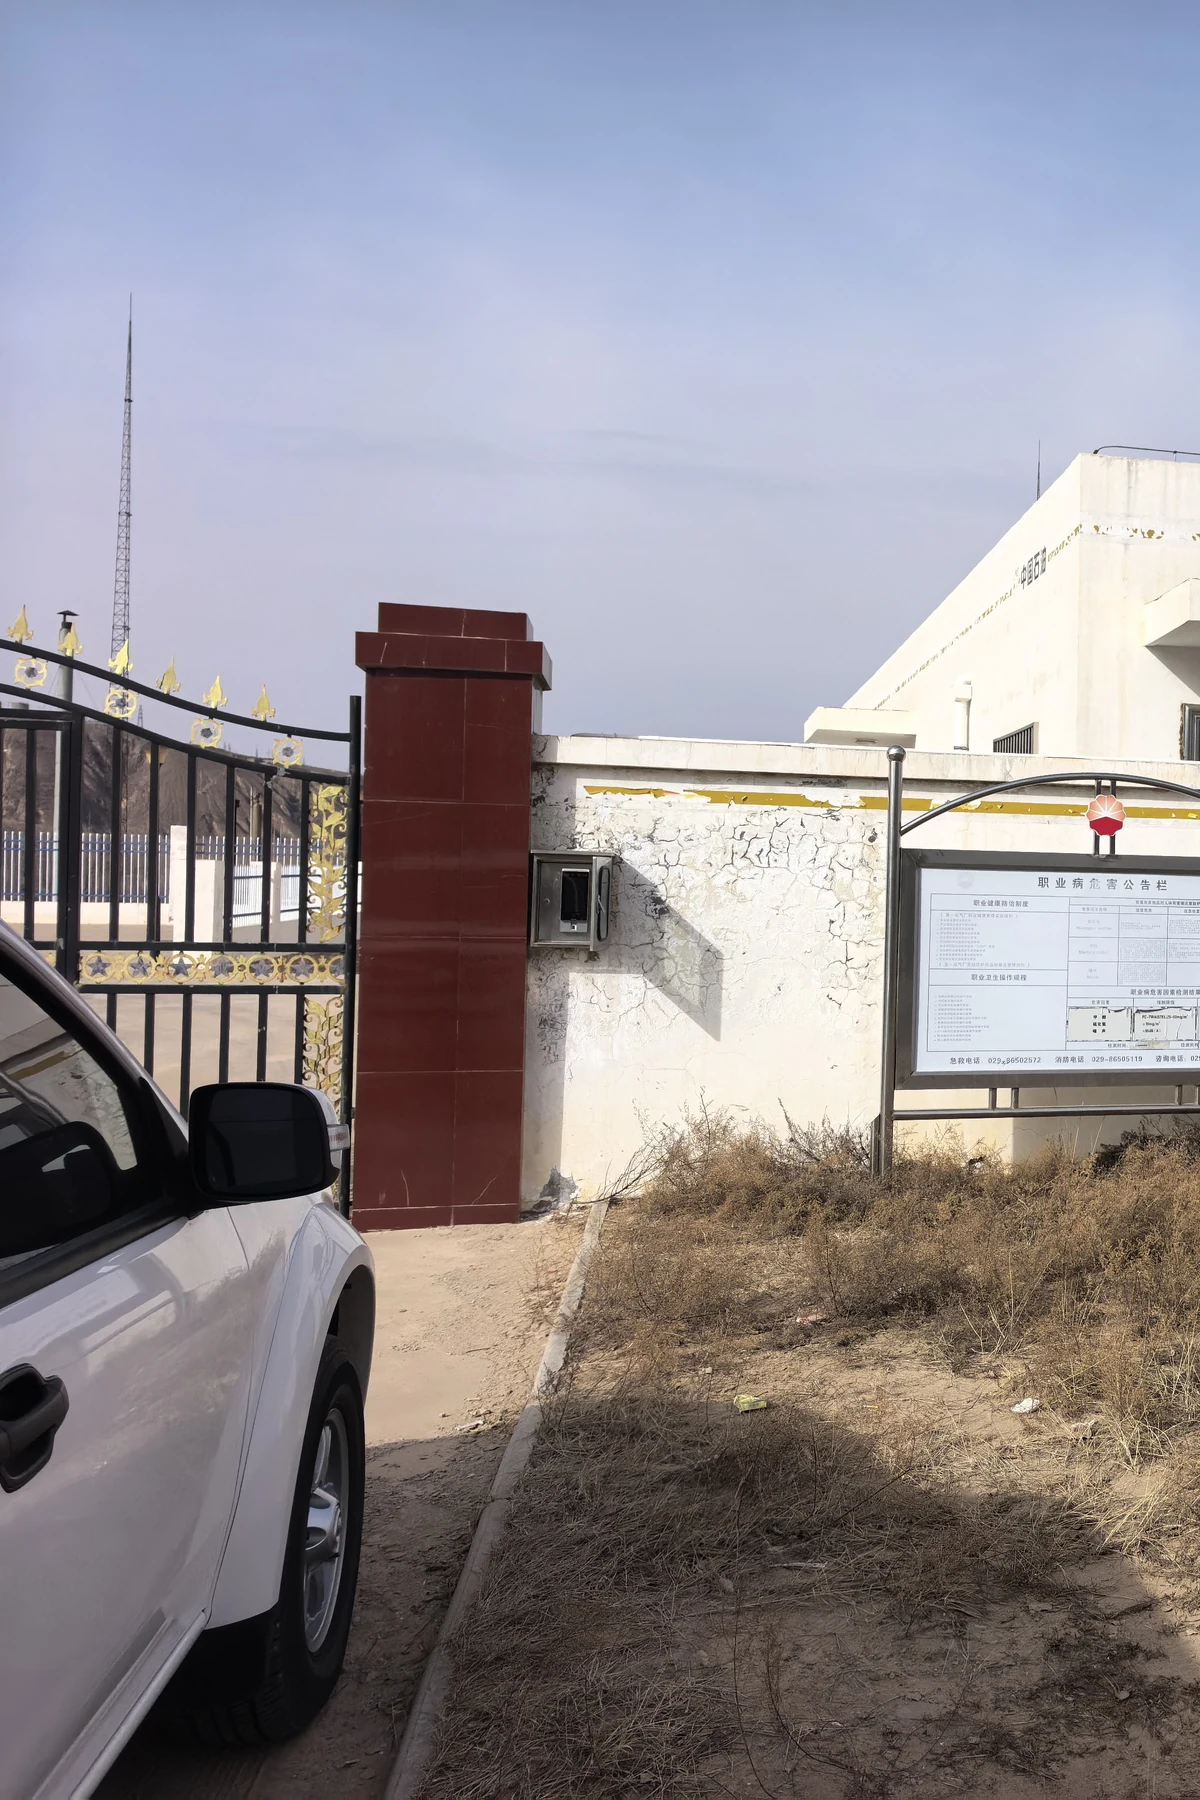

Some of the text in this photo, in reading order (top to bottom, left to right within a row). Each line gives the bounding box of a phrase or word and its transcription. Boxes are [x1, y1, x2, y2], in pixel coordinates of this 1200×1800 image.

[1037, 876, 1168, 892] 职业病危害公告栏
[973, 899, 1029, 908] 职业健康防治制度
[1091, 1055, 1143, 1063] 029-86505119
